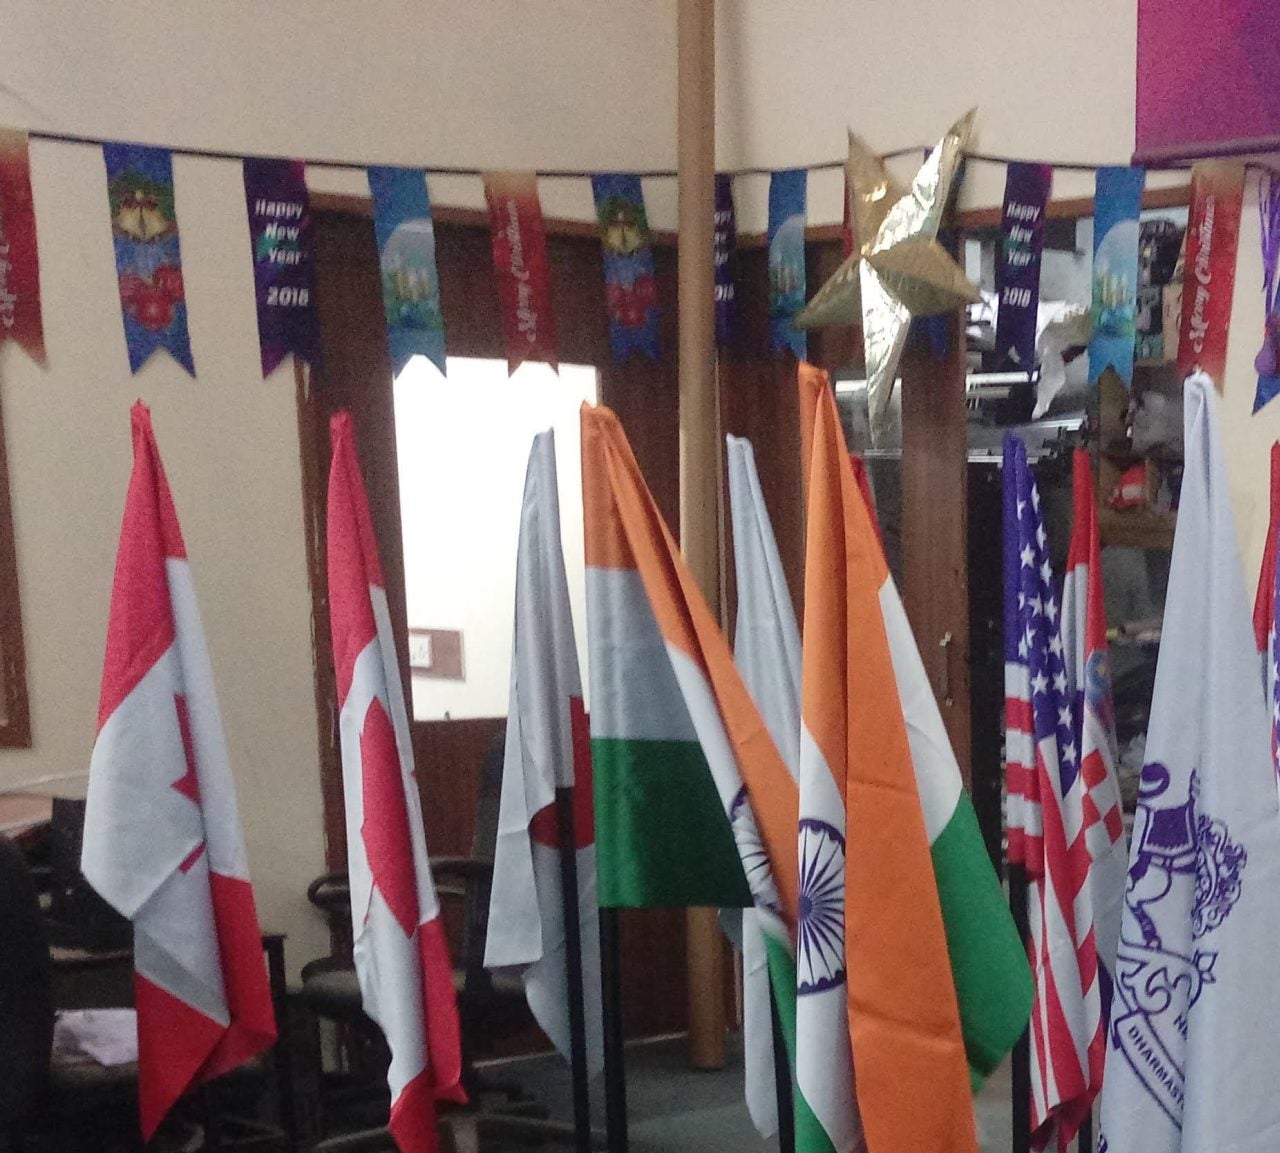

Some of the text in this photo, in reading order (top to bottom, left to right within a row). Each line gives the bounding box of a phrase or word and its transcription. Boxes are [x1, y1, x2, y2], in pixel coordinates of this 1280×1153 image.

[255, 199, 303, 219] Happy
[1006, 201, 1041, 222] Happy
[265, 221, 299, 241] New
[1010, 225, 1033, 243] New
[268, 247, 300, 264] Year
[1008, 248, 1032, 266] Year
[1002, 286, 1032, 308] 2018
